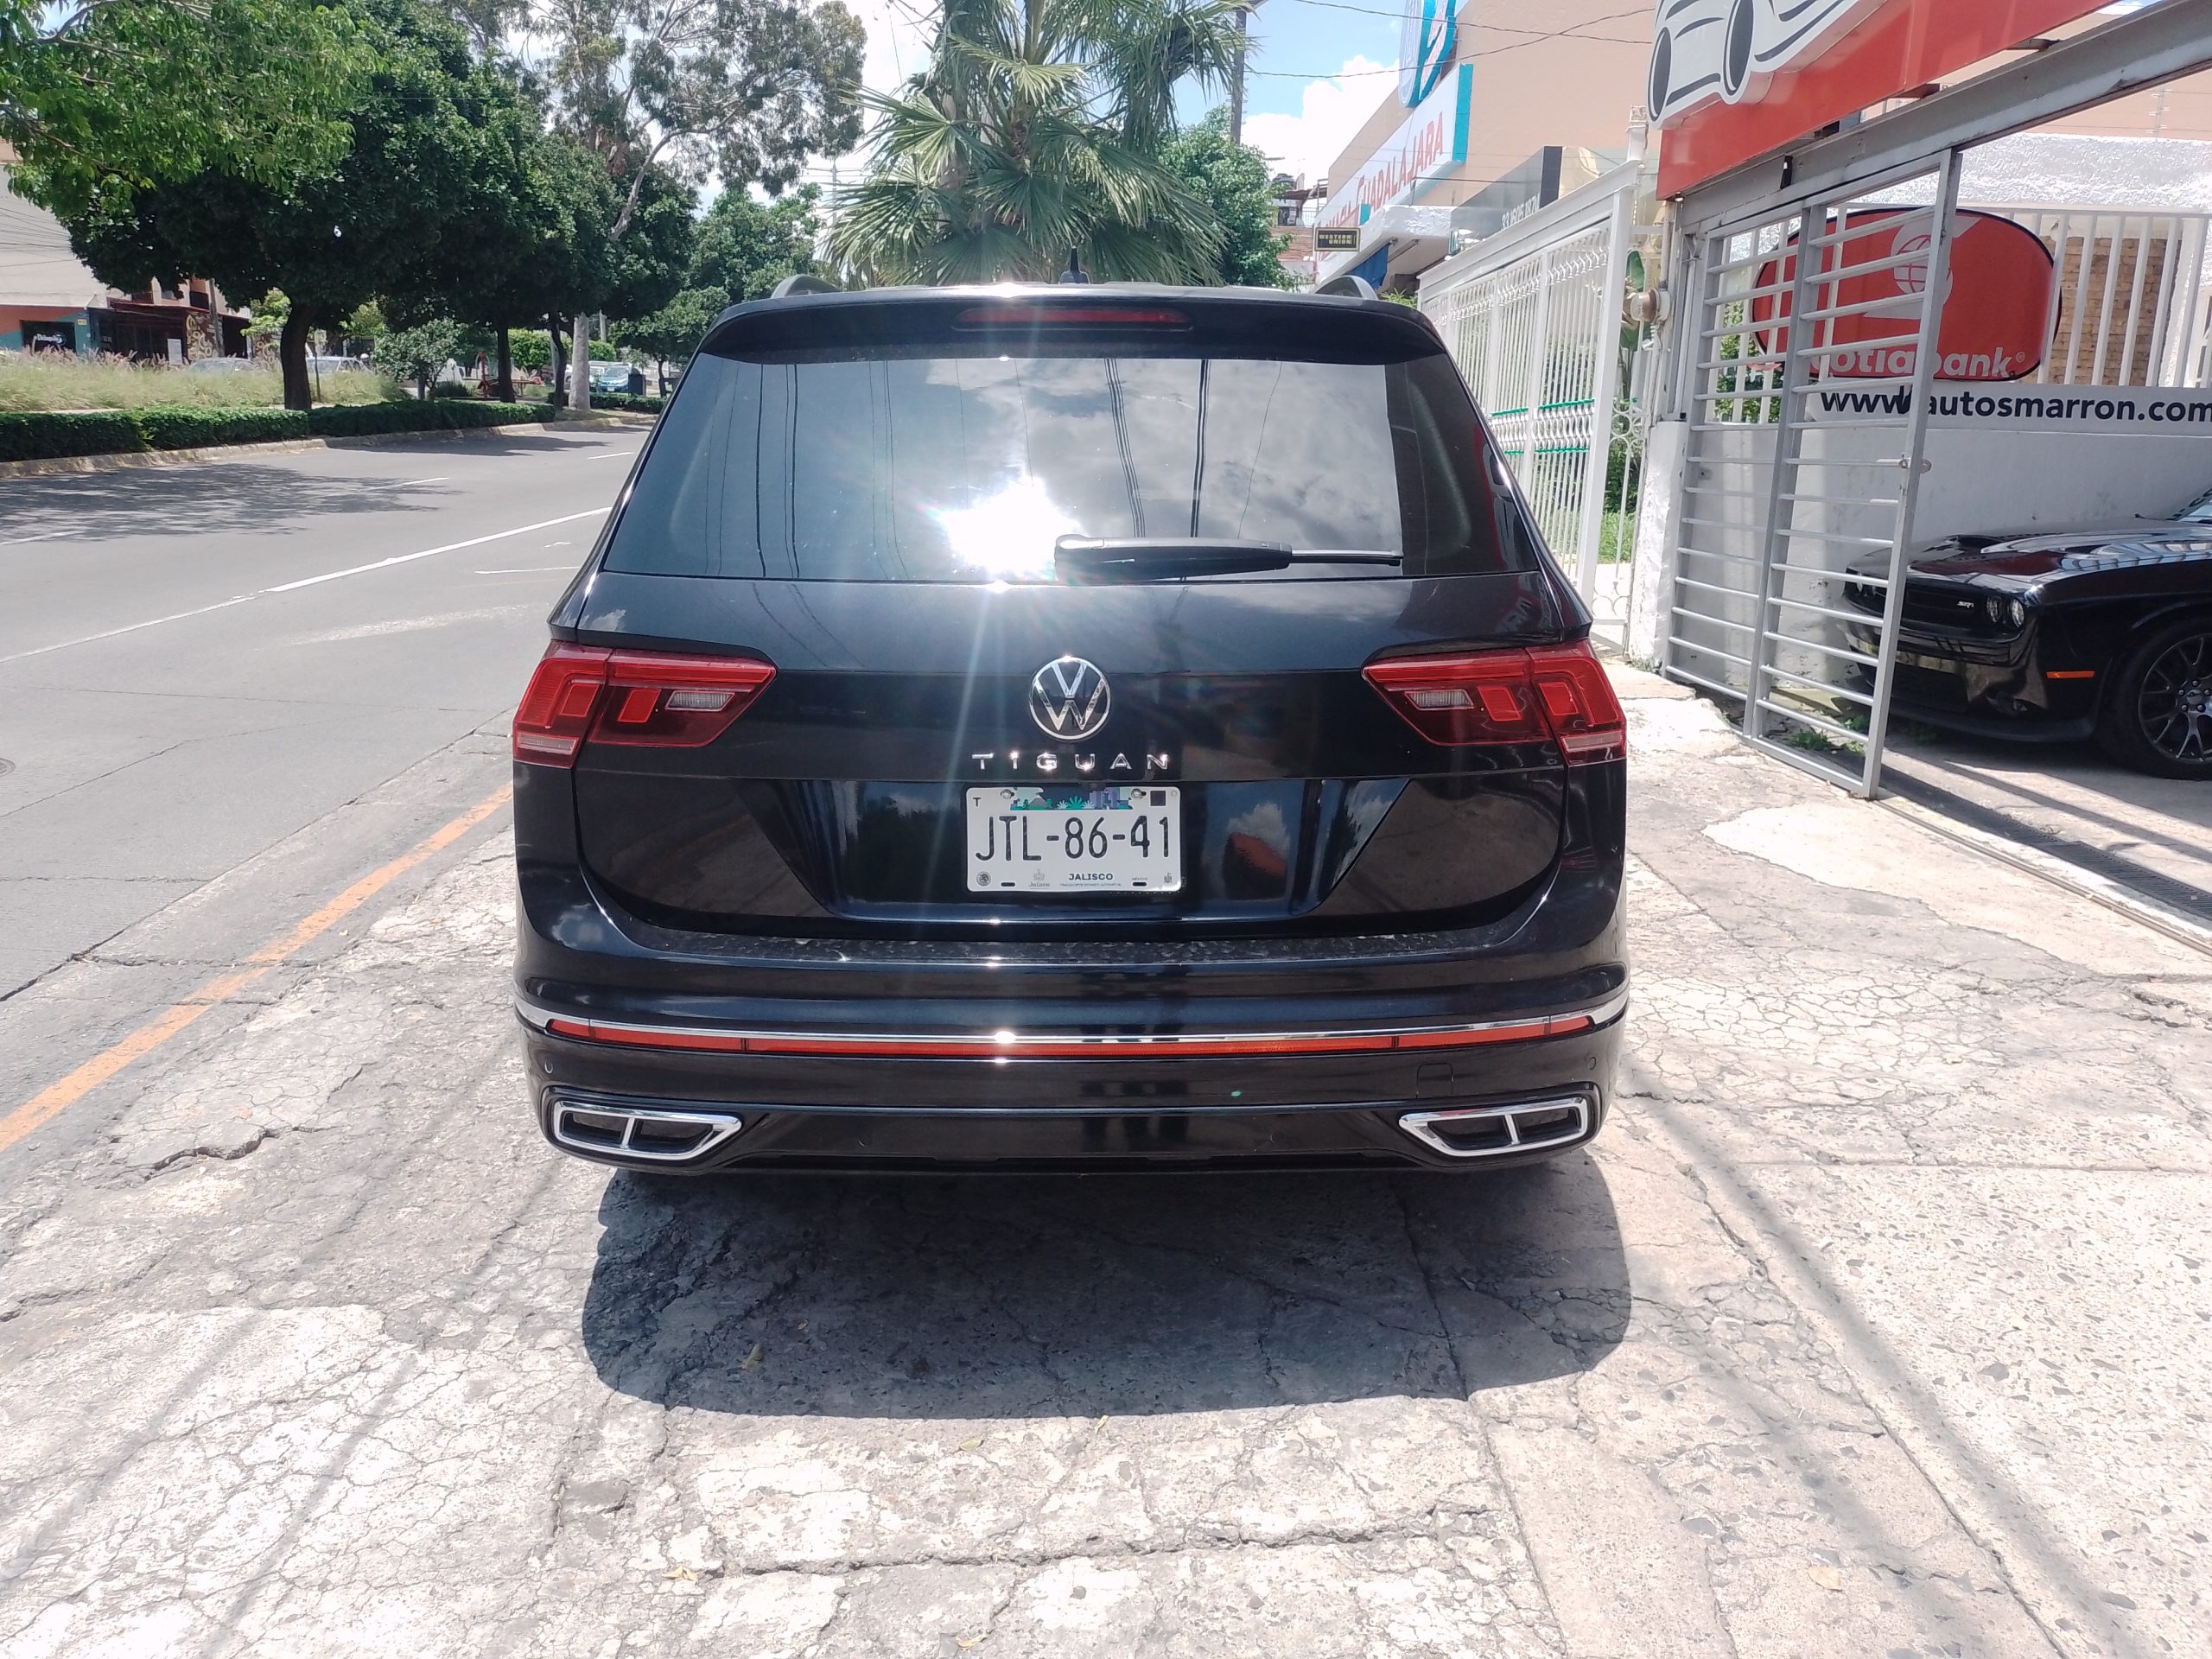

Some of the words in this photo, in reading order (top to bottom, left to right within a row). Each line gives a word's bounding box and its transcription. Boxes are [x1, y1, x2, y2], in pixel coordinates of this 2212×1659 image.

[1808, 347, 2012, 378] otiaank
[1820, 391, 2212, 423] wwwautosmarron.com
[971, 753, 1168, 771] TIGUAN
[976, 815, 1169, 861] JTL-86-41
